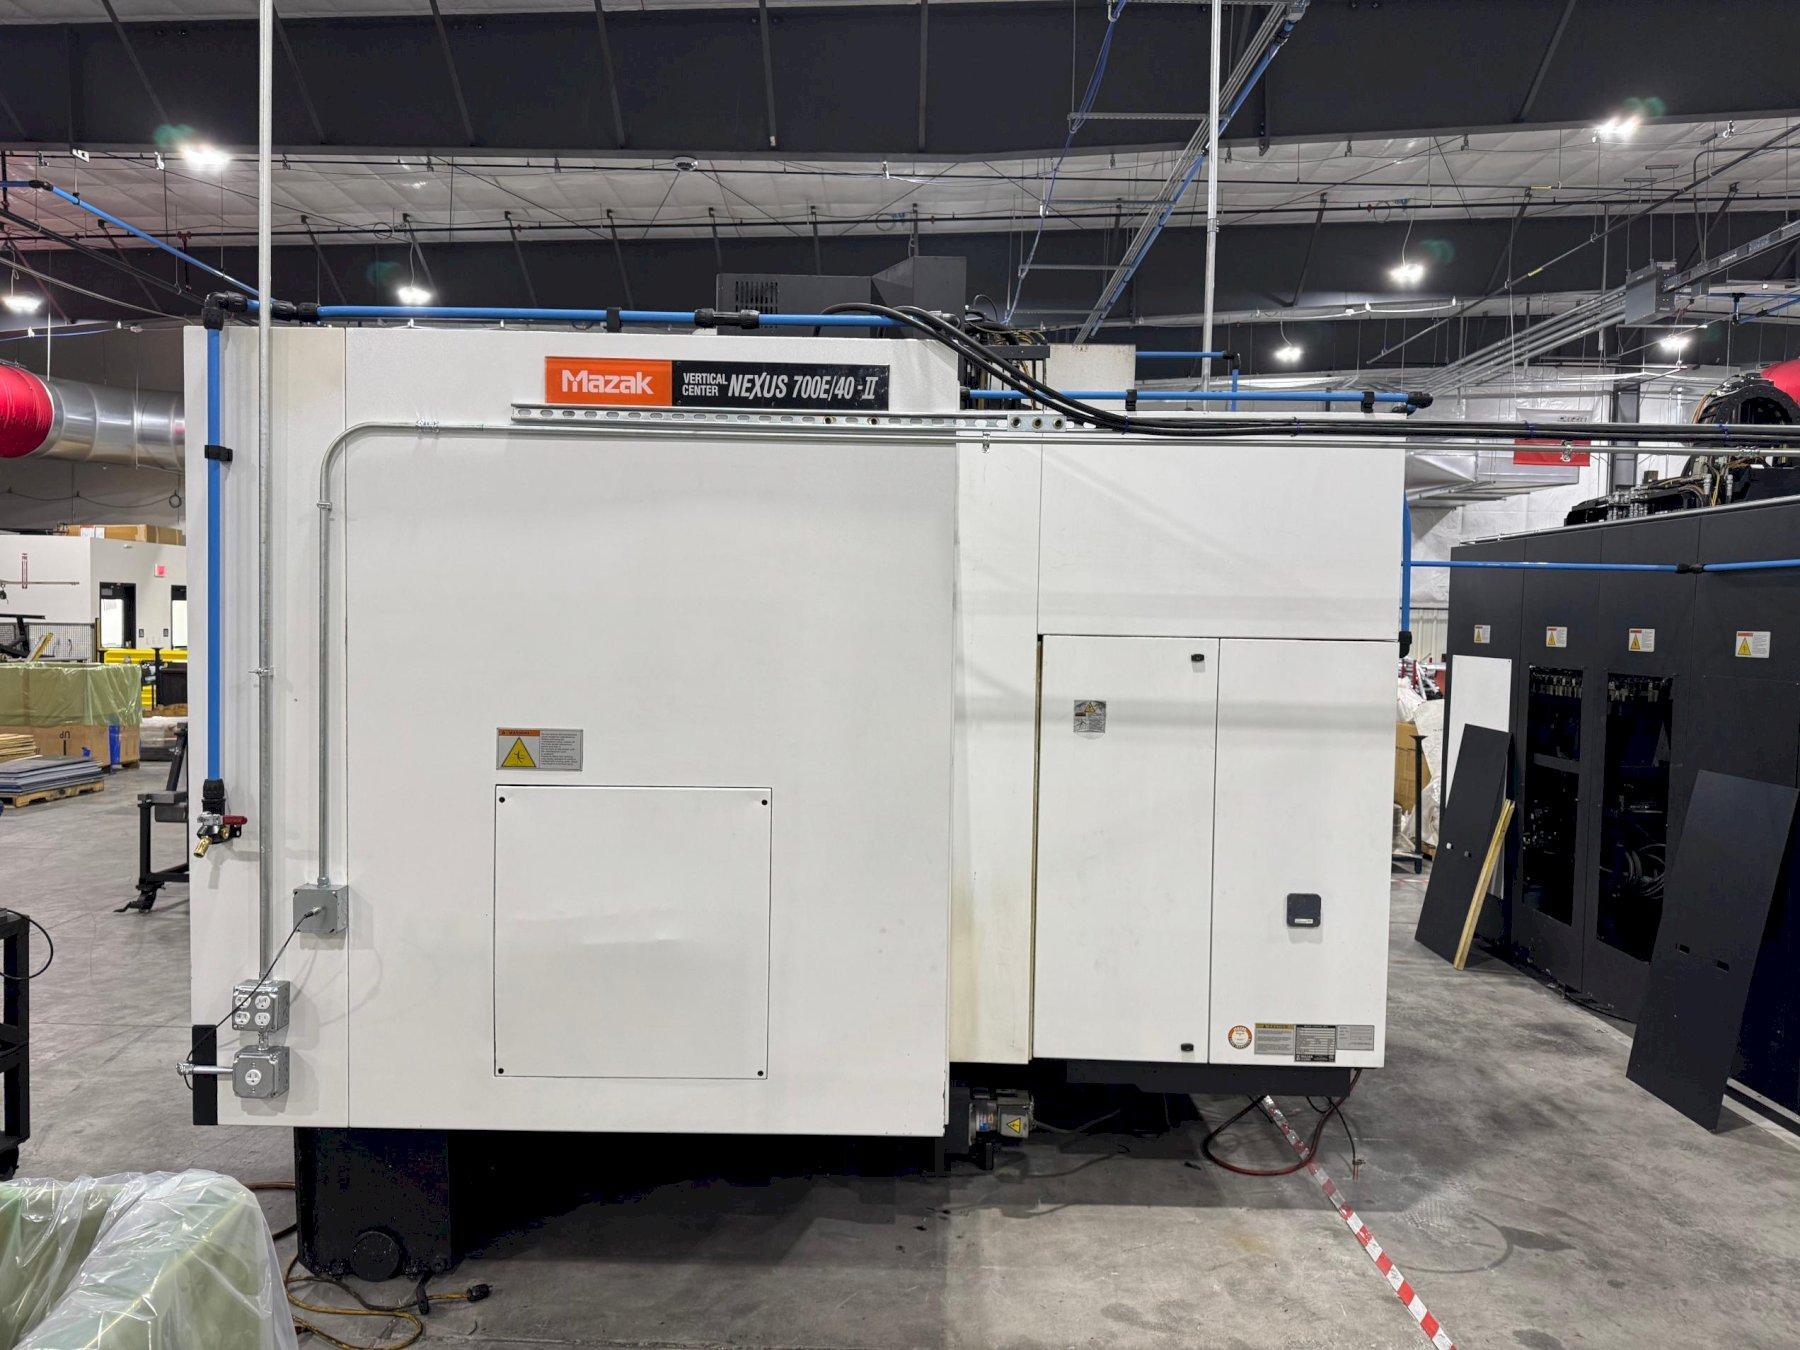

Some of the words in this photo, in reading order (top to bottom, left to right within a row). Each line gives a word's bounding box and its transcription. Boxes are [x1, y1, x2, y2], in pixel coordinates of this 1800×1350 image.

[561, 369, 654, 395] Mazak
[683, 372, 728, 385] VERTICAL
[727, 372, 788, 399] NEXUS
[792, 375, 855, 402] 700E/40
[682, 384, 719, 397] CENTER
